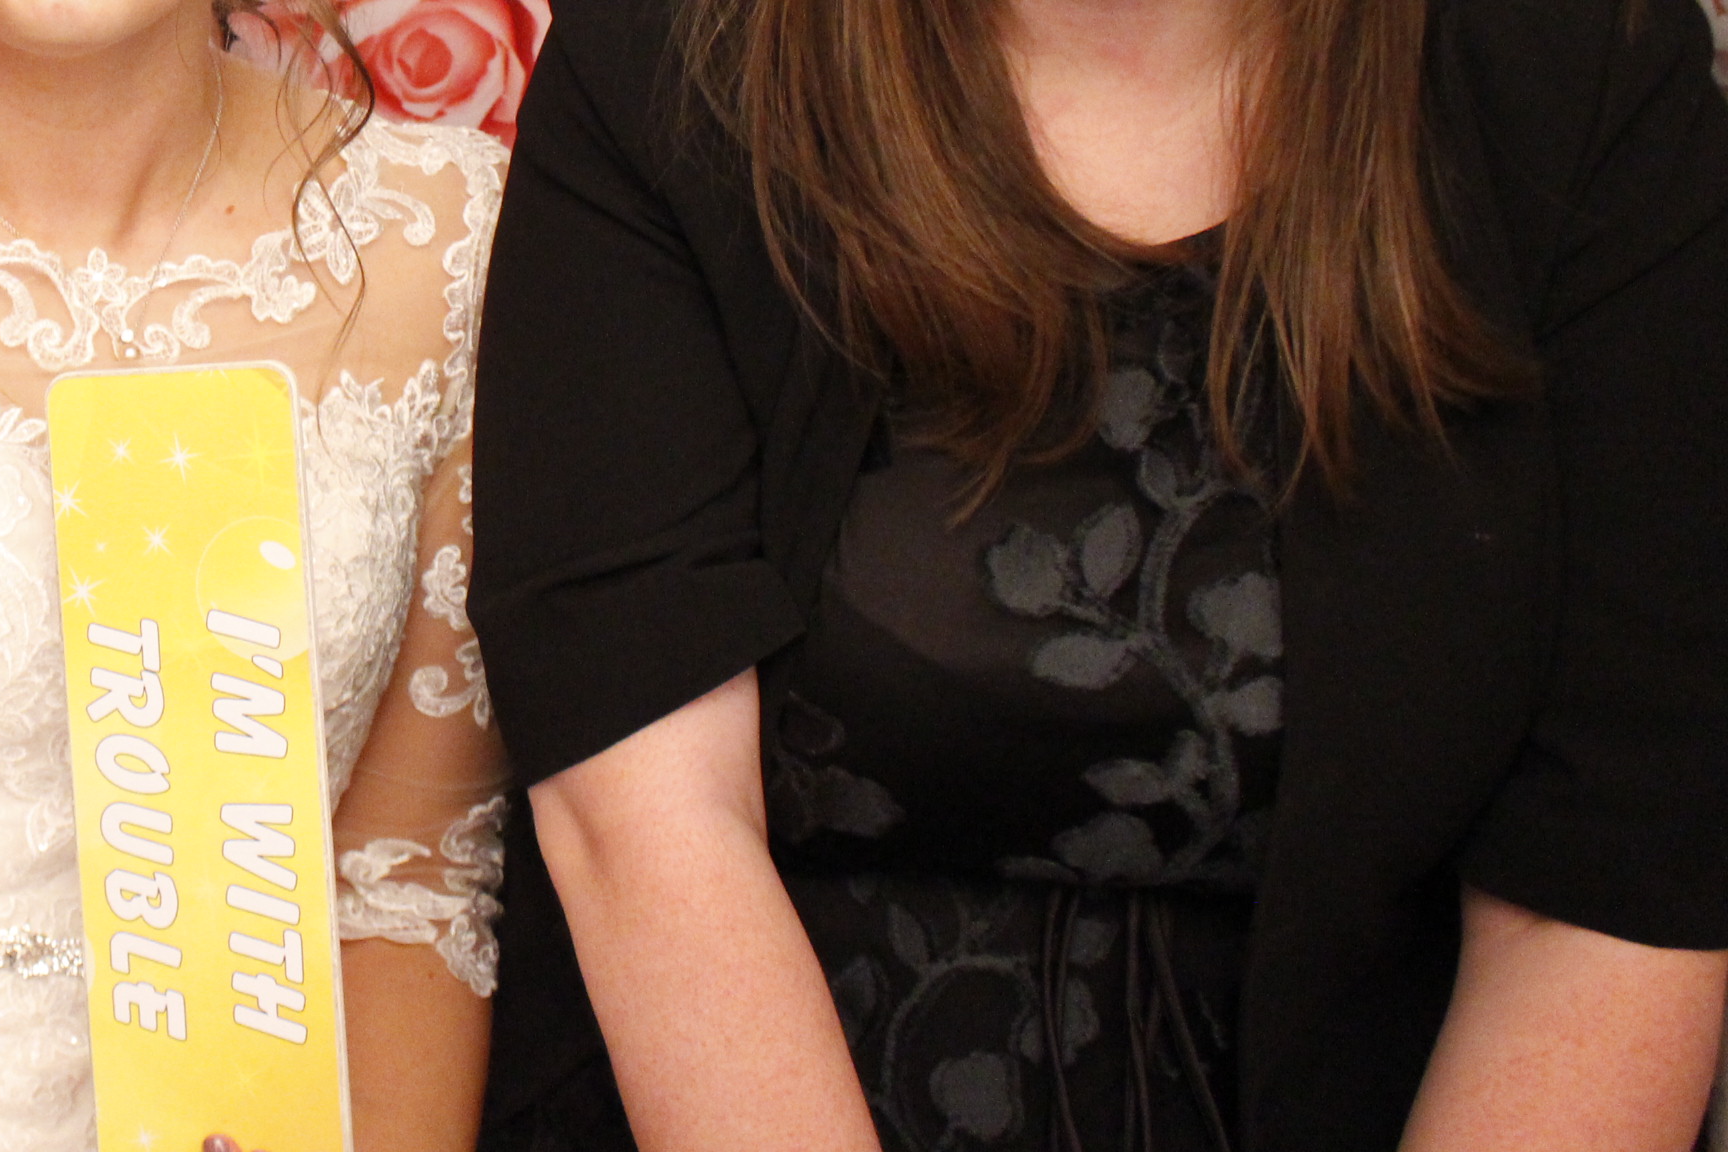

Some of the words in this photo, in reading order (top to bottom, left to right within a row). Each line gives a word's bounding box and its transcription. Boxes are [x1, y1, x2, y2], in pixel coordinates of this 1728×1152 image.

[206, 608, 289, 760] I'M
[85, 618, 189, 1043] TROUBLE
[219, 802, 309, 1046] WITH
